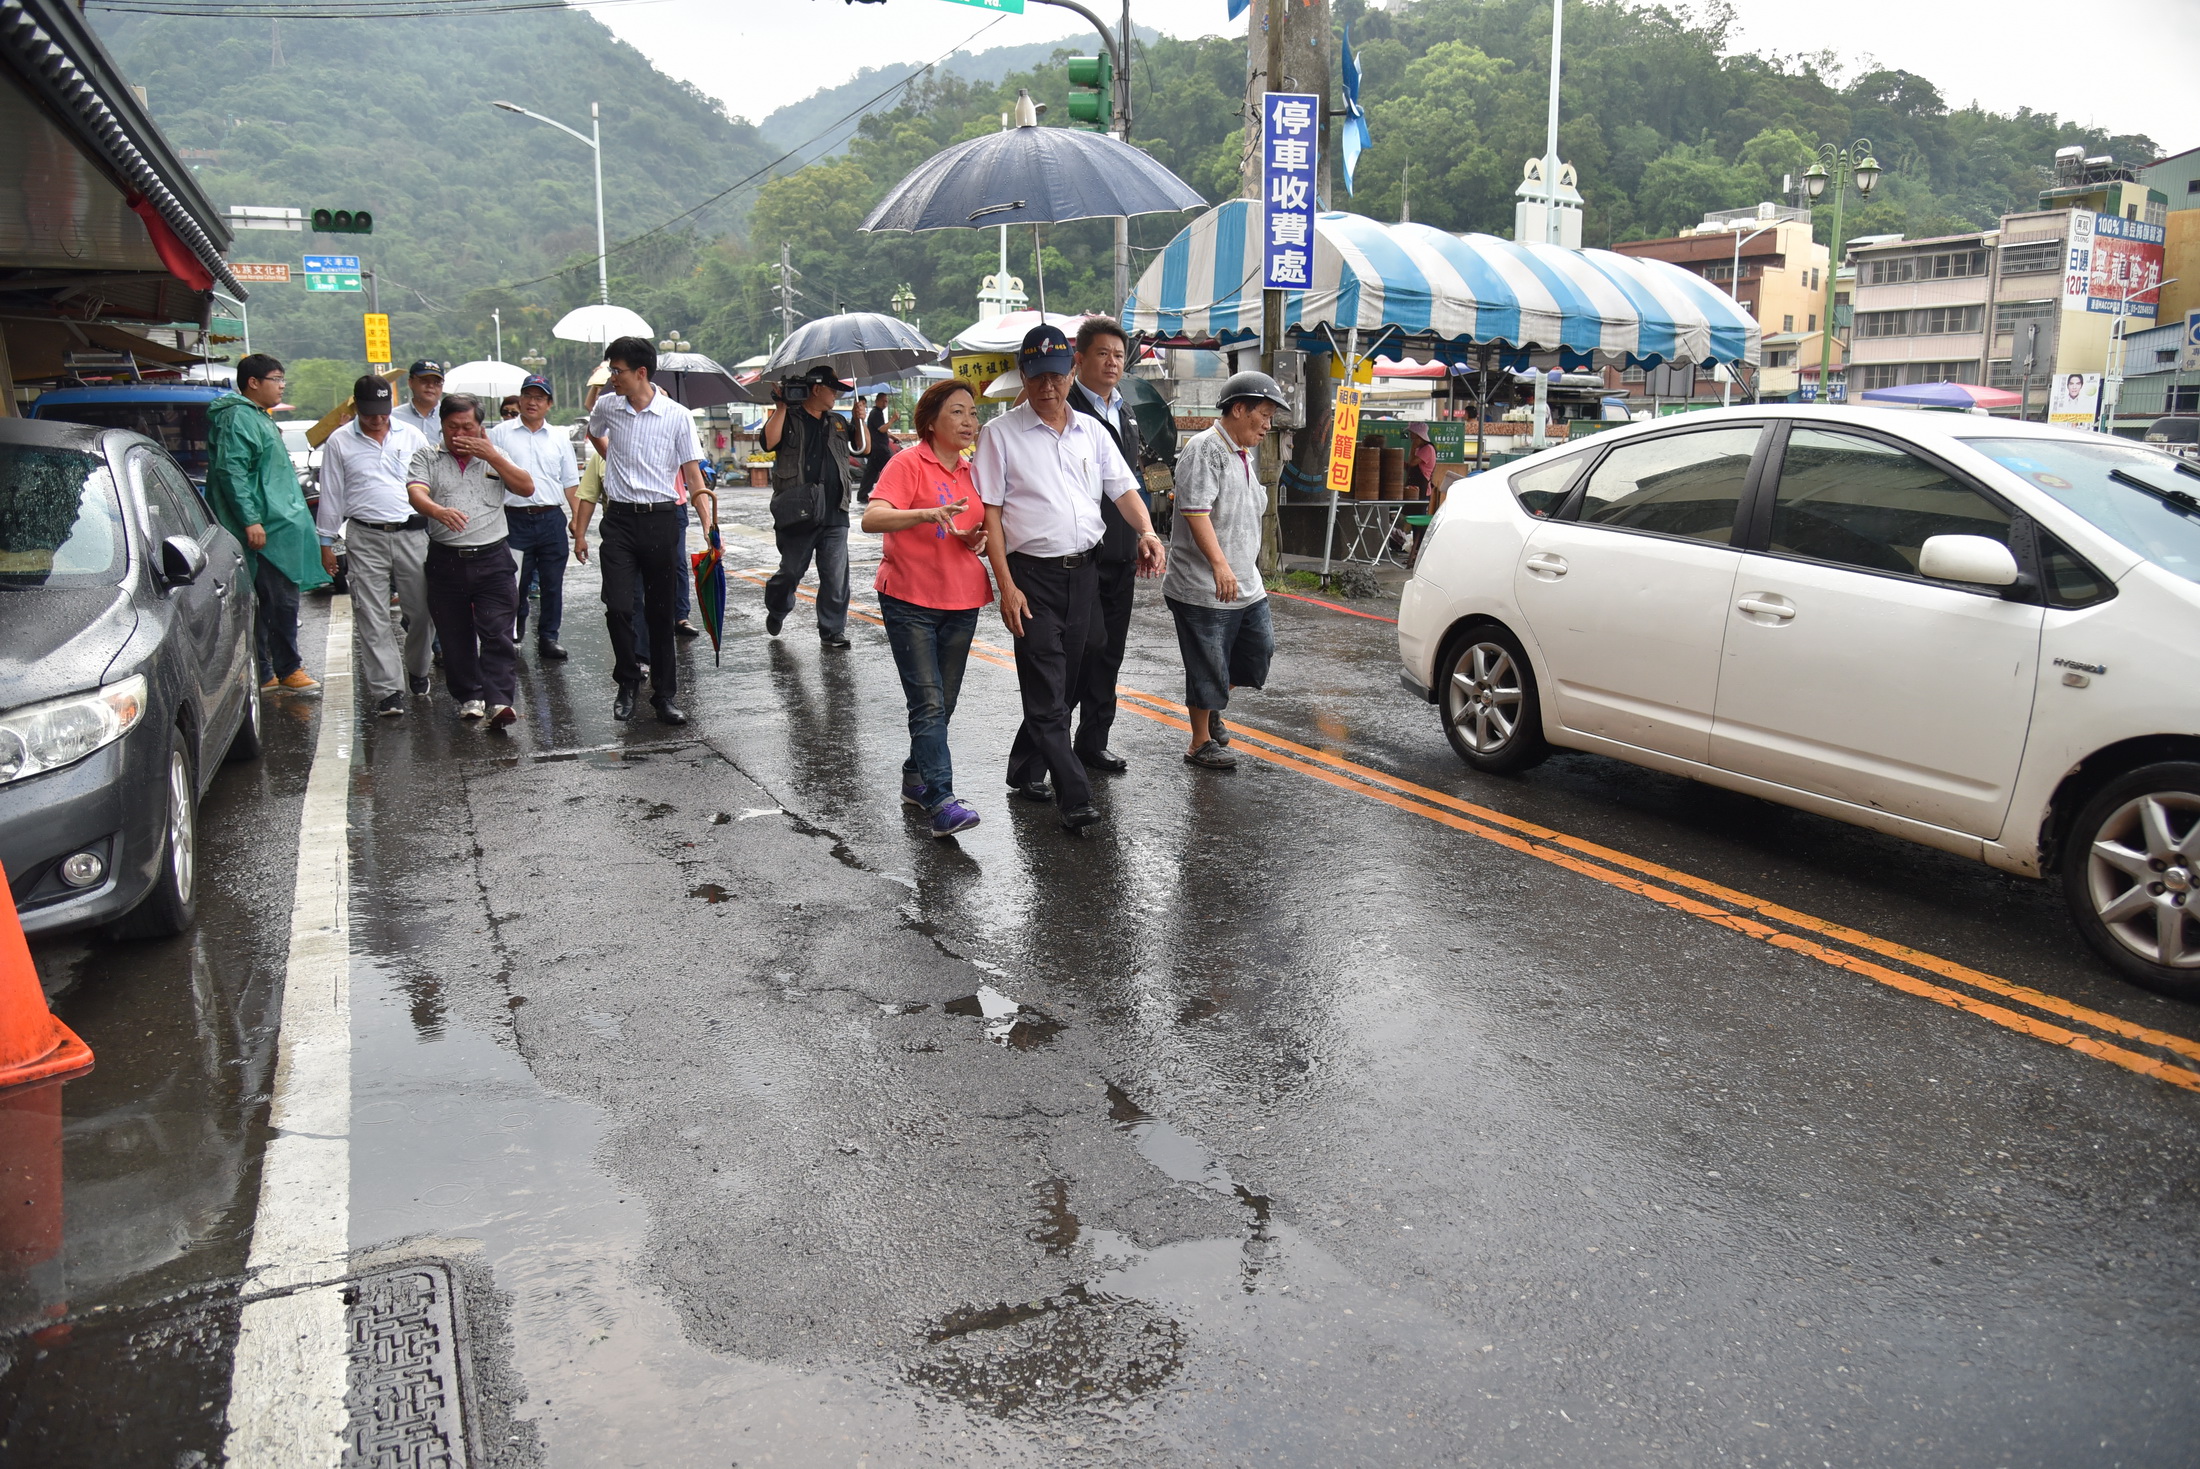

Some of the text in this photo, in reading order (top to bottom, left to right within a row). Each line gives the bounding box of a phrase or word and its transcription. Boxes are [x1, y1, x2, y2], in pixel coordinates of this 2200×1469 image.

[1271, 101, 1311, 283] 停車收費處
[2098, 217, 2121, 235] 100%
[231, 264, 286, 275] 九族文化村
[323, 257, 355, 267] 火車站
[2069, 248, 2089, 272] 日曝
[2065, 275, 2089, 295] 120天
[958, 359, 1011, 378] 現作祖傳
[1338, 389, 1359, 407] 祖傳
[1331, 407, 1355, 487] 小籠包
